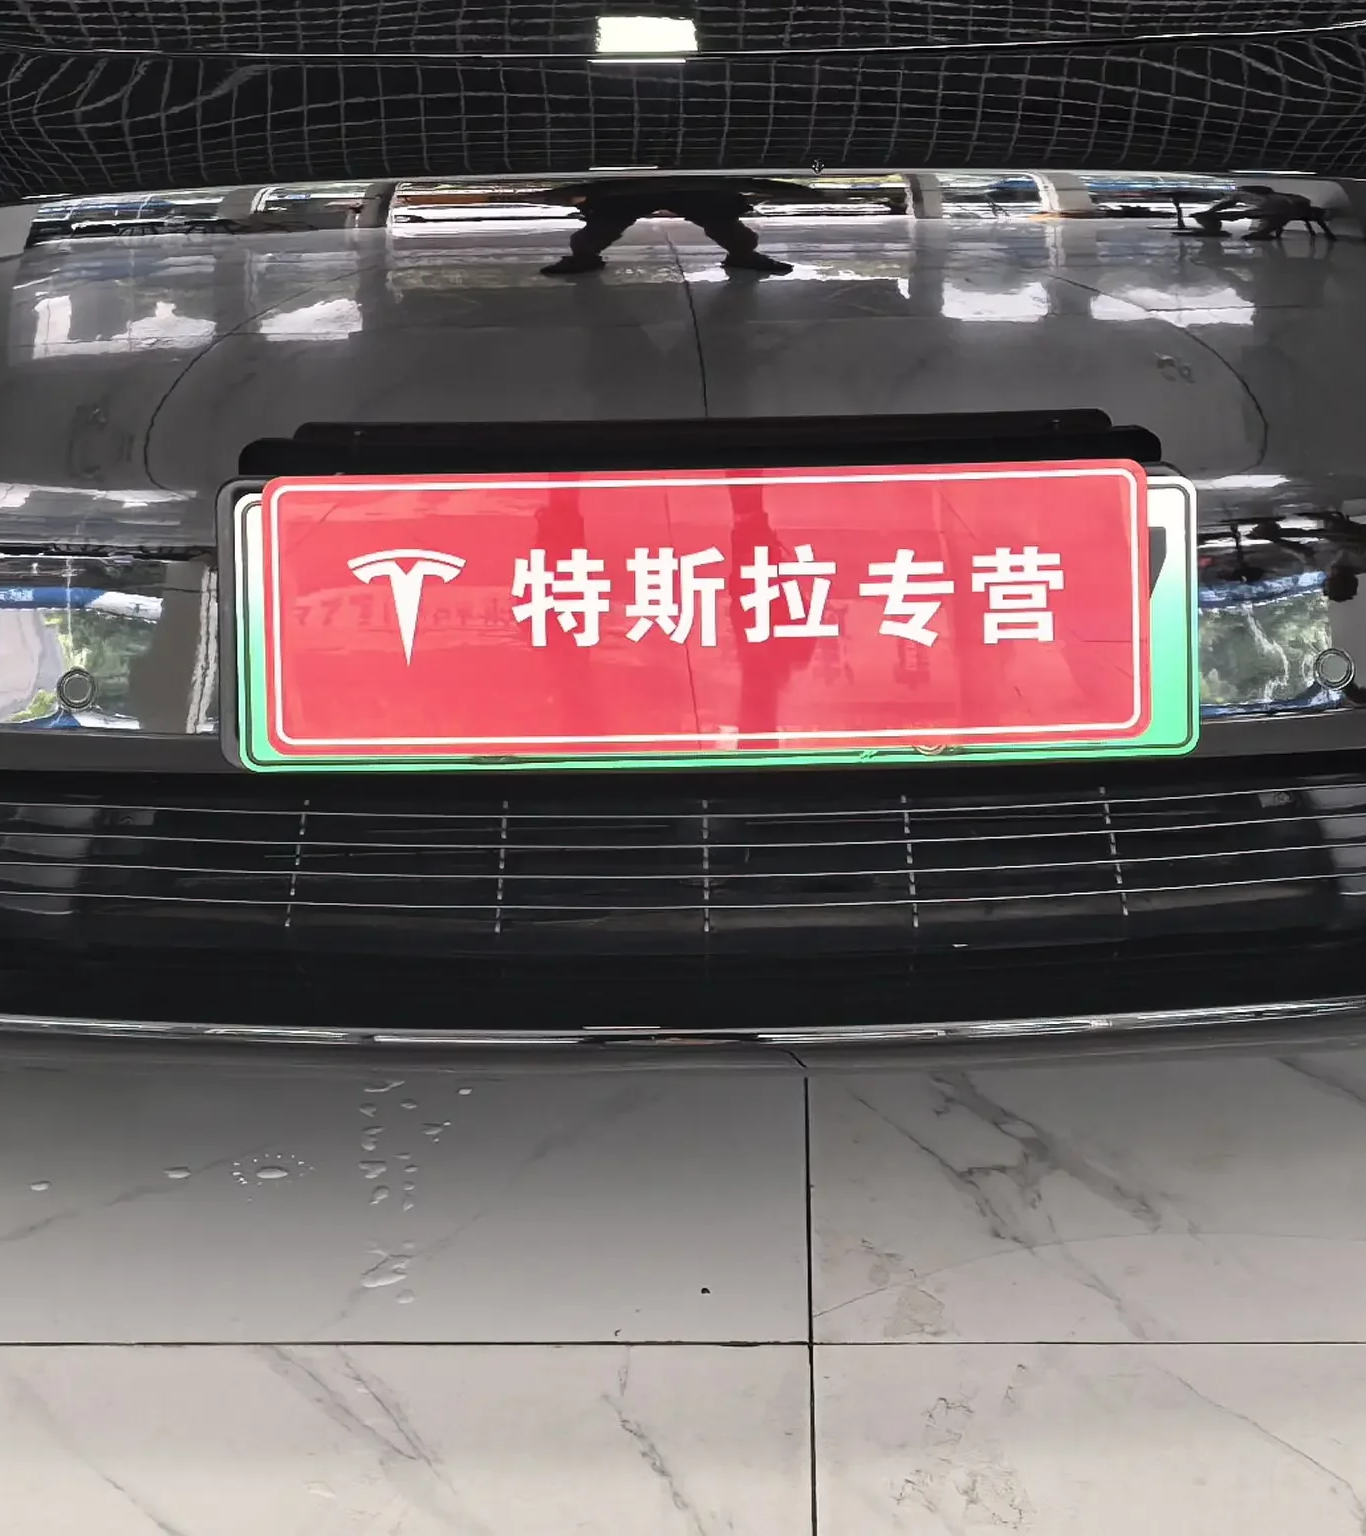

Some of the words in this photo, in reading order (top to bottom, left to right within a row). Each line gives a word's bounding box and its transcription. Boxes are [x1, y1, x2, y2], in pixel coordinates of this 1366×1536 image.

[511, 544, 1064, 648] 特斯拉专营
